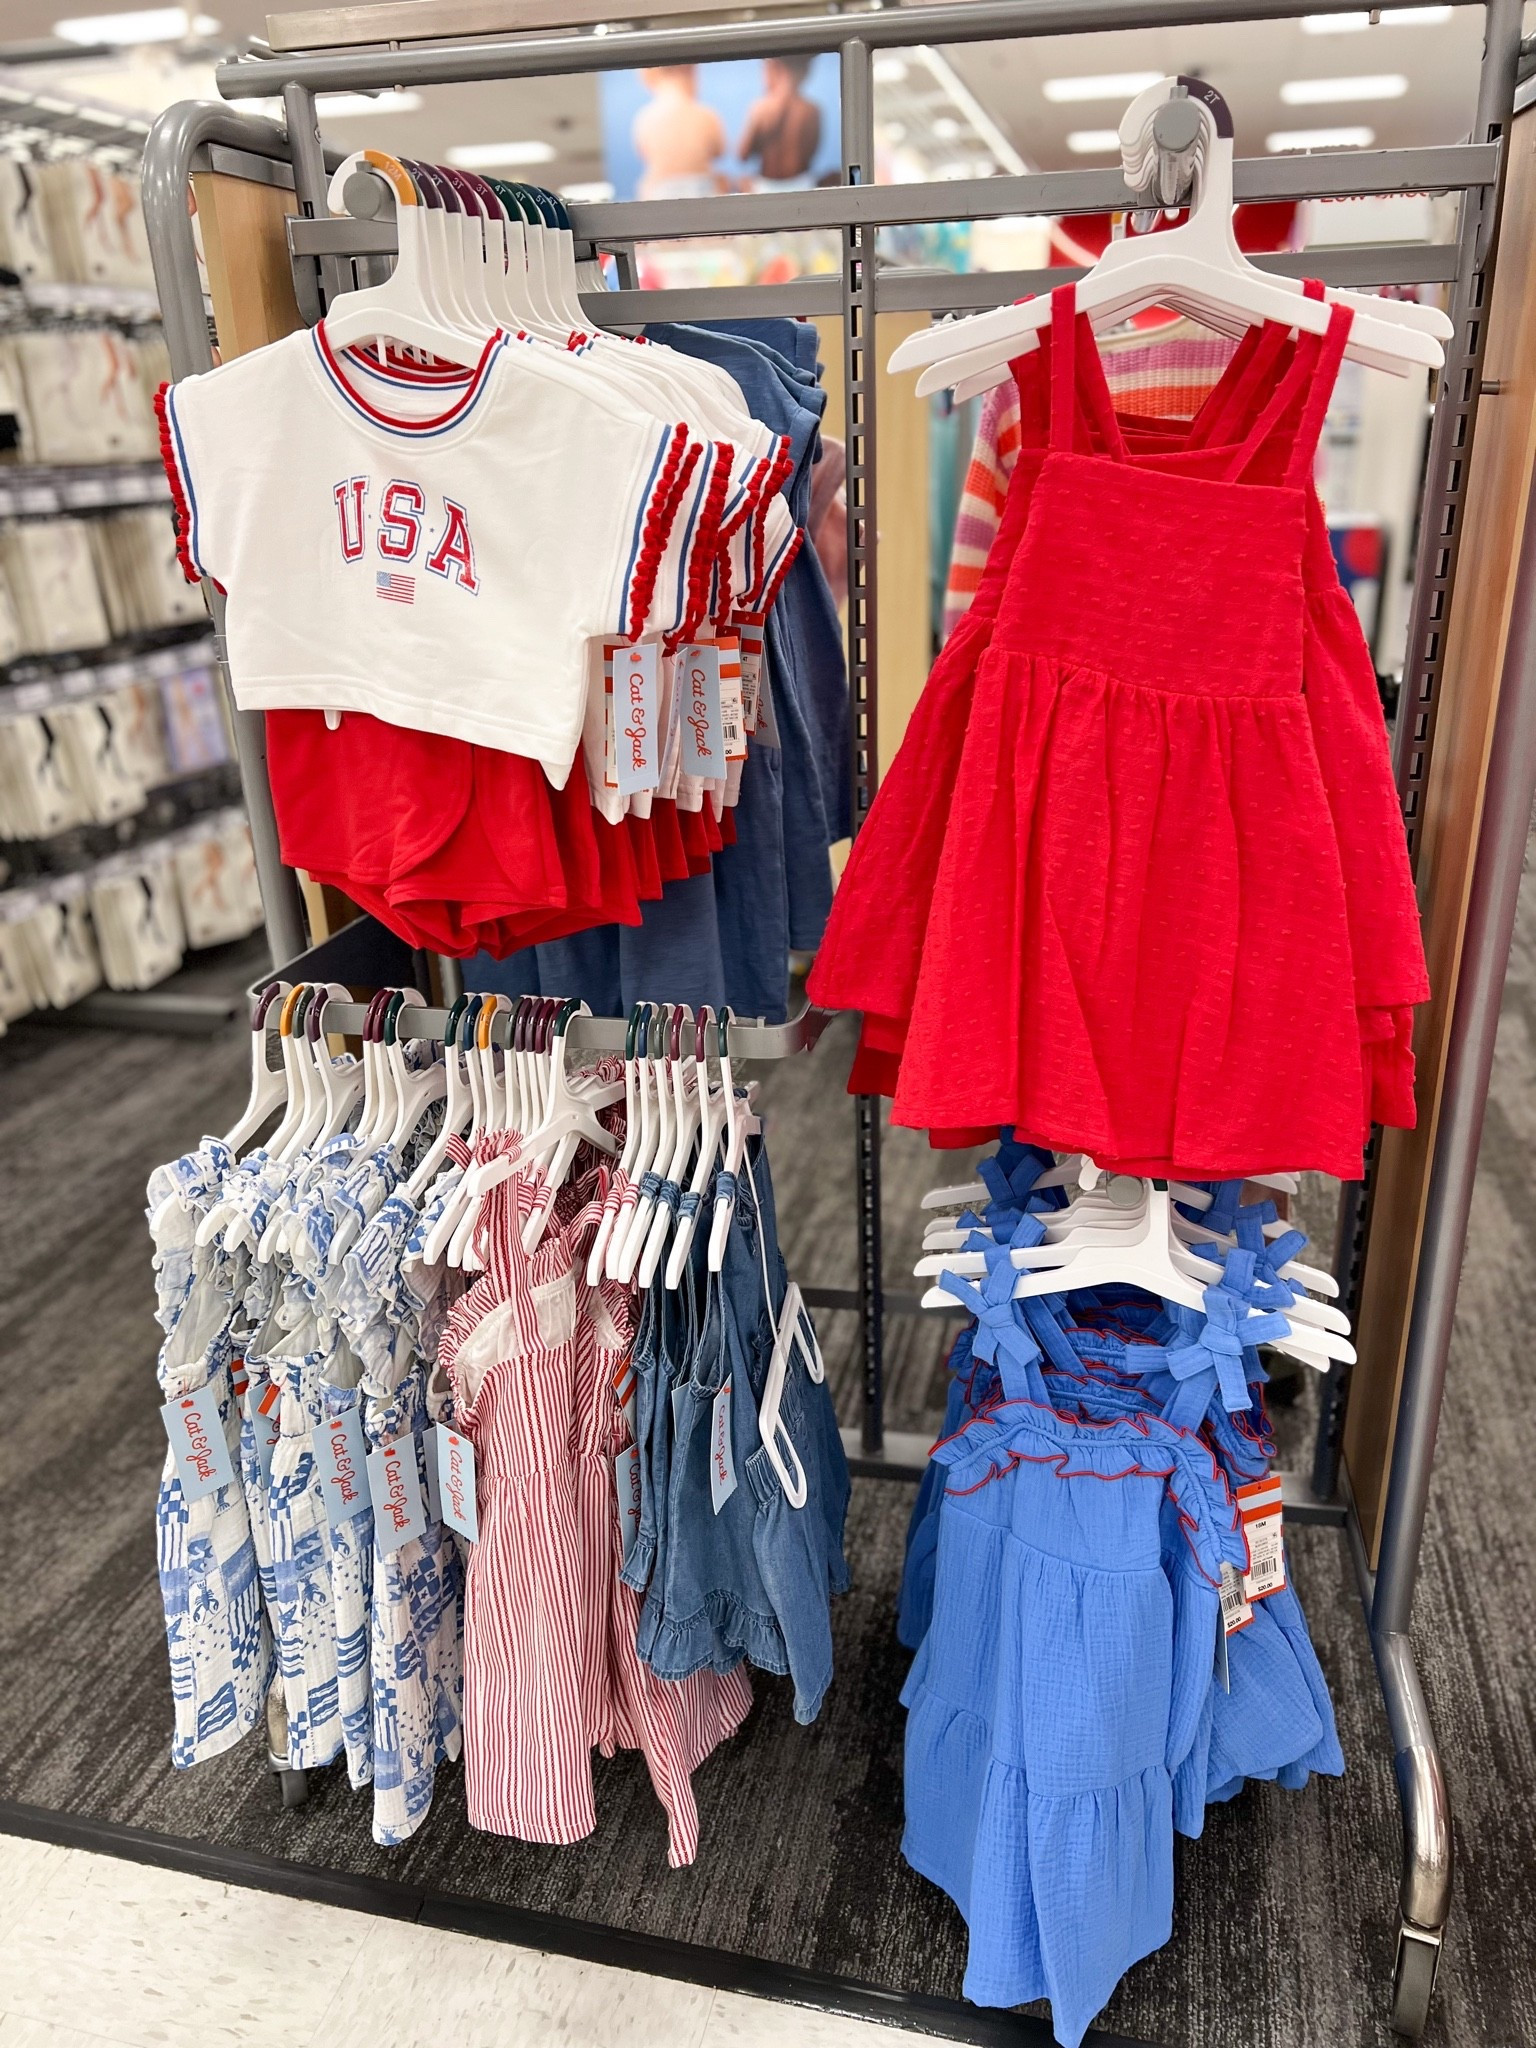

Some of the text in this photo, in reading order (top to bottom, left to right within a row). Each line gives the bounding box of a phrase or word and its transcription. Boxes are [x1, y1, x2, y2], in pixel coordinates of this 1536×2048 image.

[1203, 90, 1221, 104] 2T
[384, 161, 403, 181] 12M
[411, 167, 423, 180] 2T
[431, 173, 444, 186] 2T
[452, 177, 465, 190] 3T
[475, 183, 488, 196] 3T
[494, 184, 507, 195] 4T
[515, 191, 526, 202] 4T
[535, 194, 547, 205] 5T
[687, 668, 712, 757] Cat & Jack
[624, 673, 647, 771] Cat & Jack
[184, 1412, 217, 1482] Cat & Jack
[330, 1433, 359, 1505] Cat & Jack
[715, 1445, 727, 1486] Jack
[445, 1449, 467, 1521] Cat & Jack
[383, 1460, 411, 1532] Cat & Jack
[1257, 1582, 1273, 1592] $20.00
[1227, 1616, 1242, 1628] $20.00
